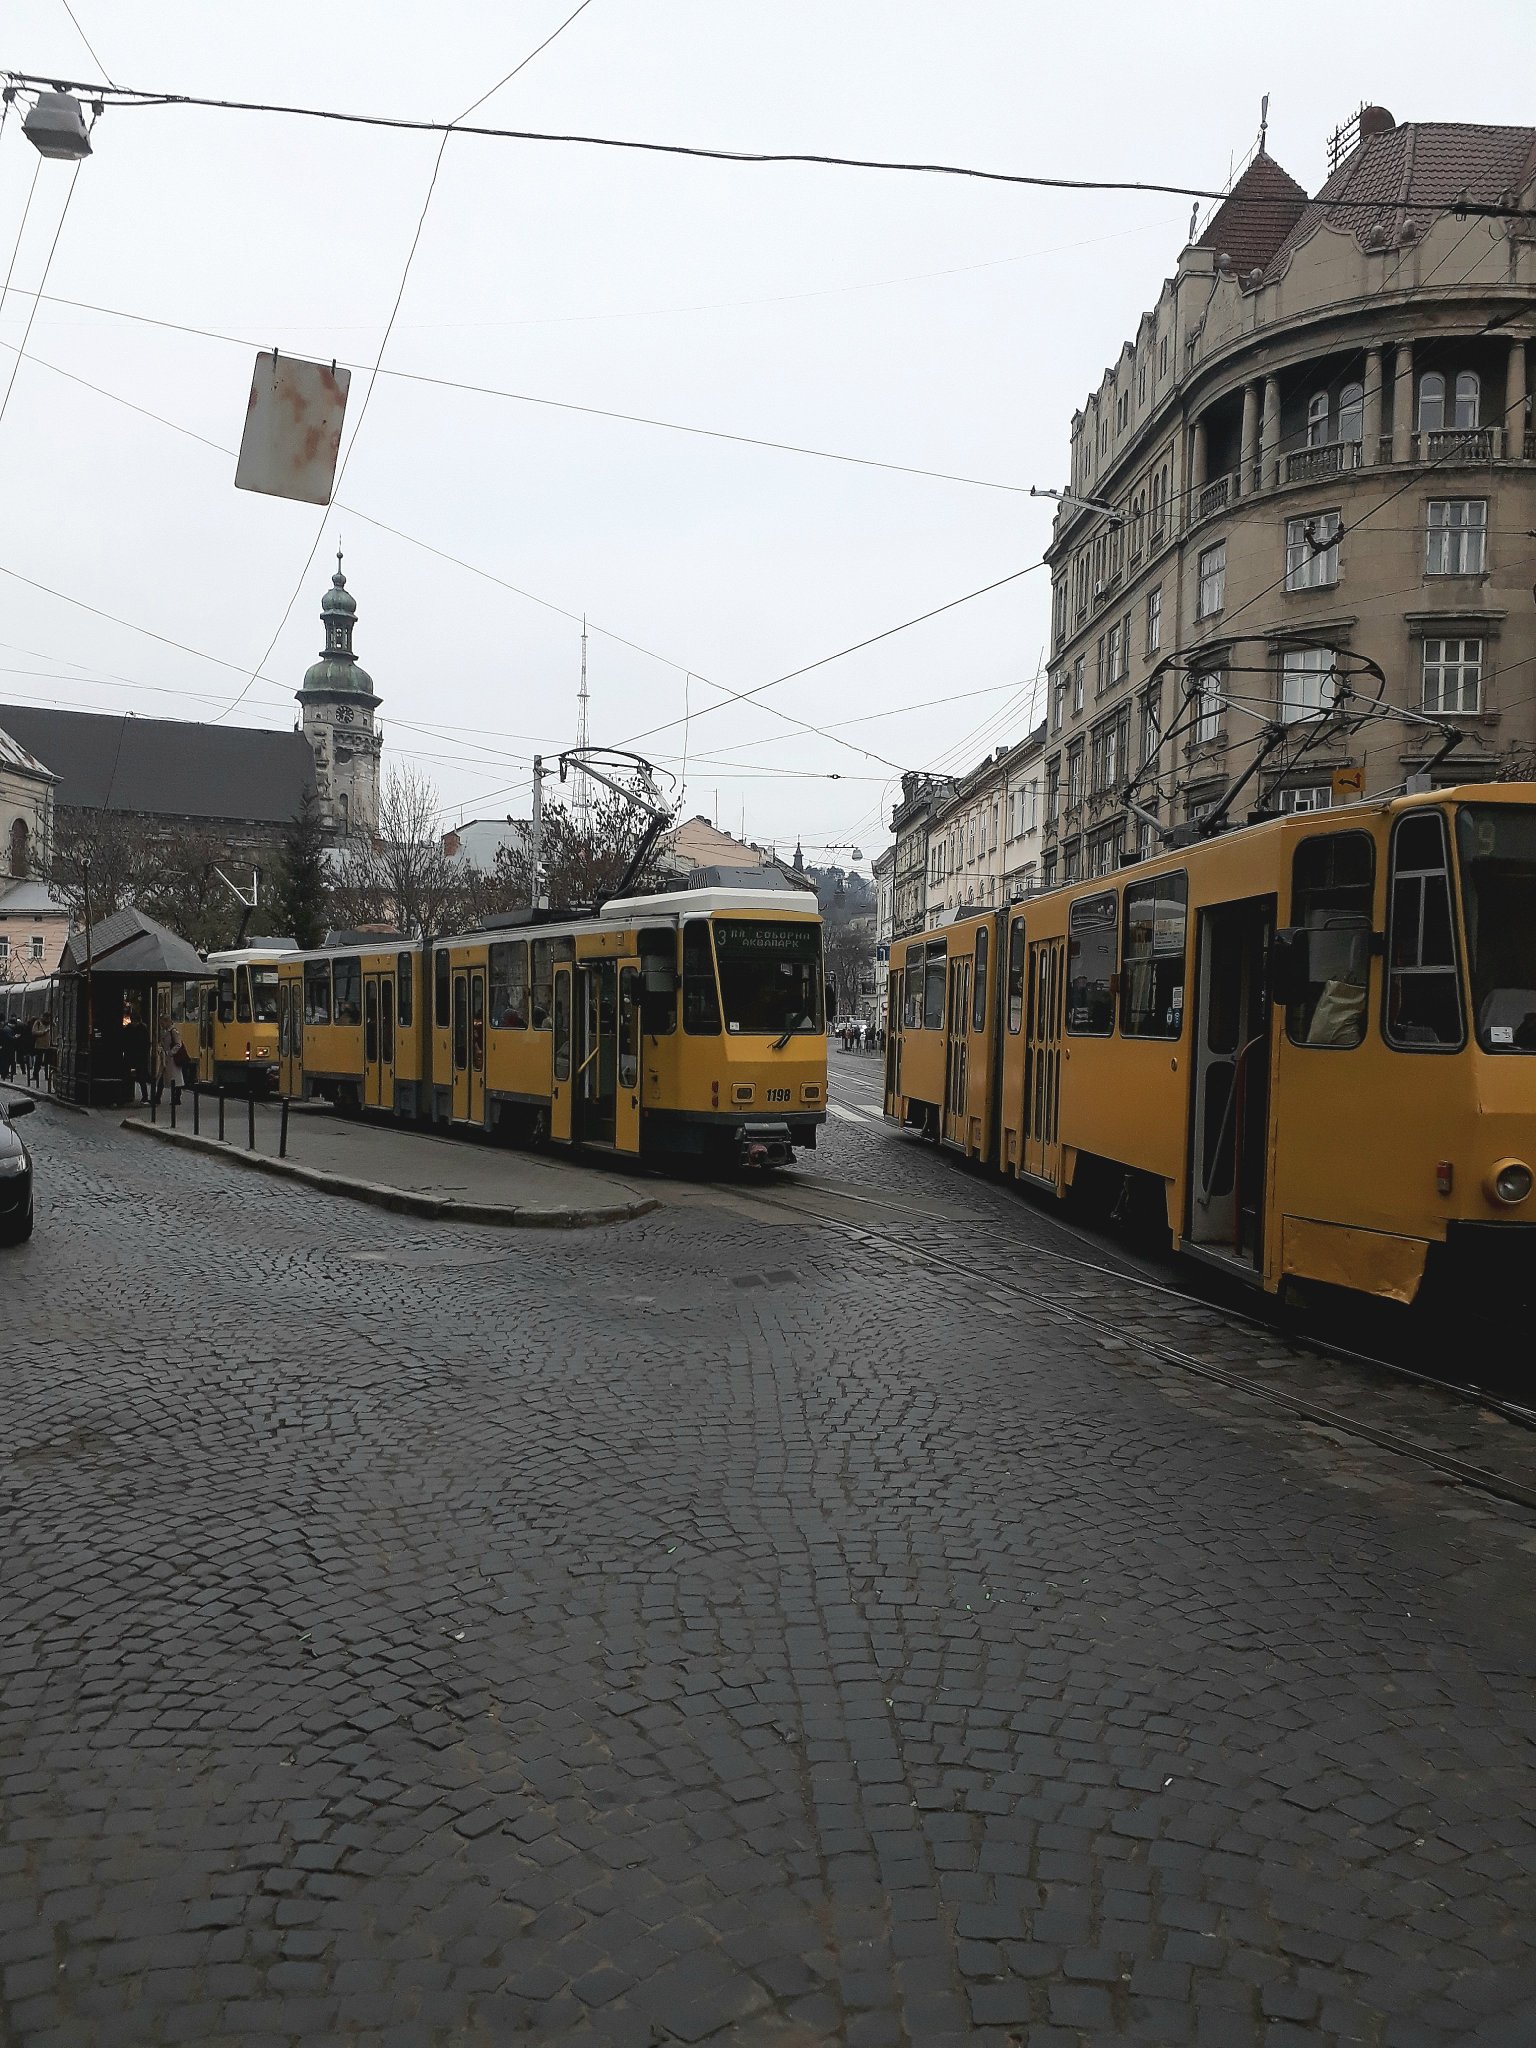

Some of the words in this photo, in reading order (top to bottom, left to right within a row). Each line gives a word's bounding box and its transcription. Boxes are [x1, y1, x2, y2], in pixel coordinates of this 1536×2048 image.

[717, 929, 727, 946] 3
[756, 931, 810, 941] СОБОРНА
[742, 938, 800, 948] АКВАПАРК
[766, 1089, 791, 1101] 1198
